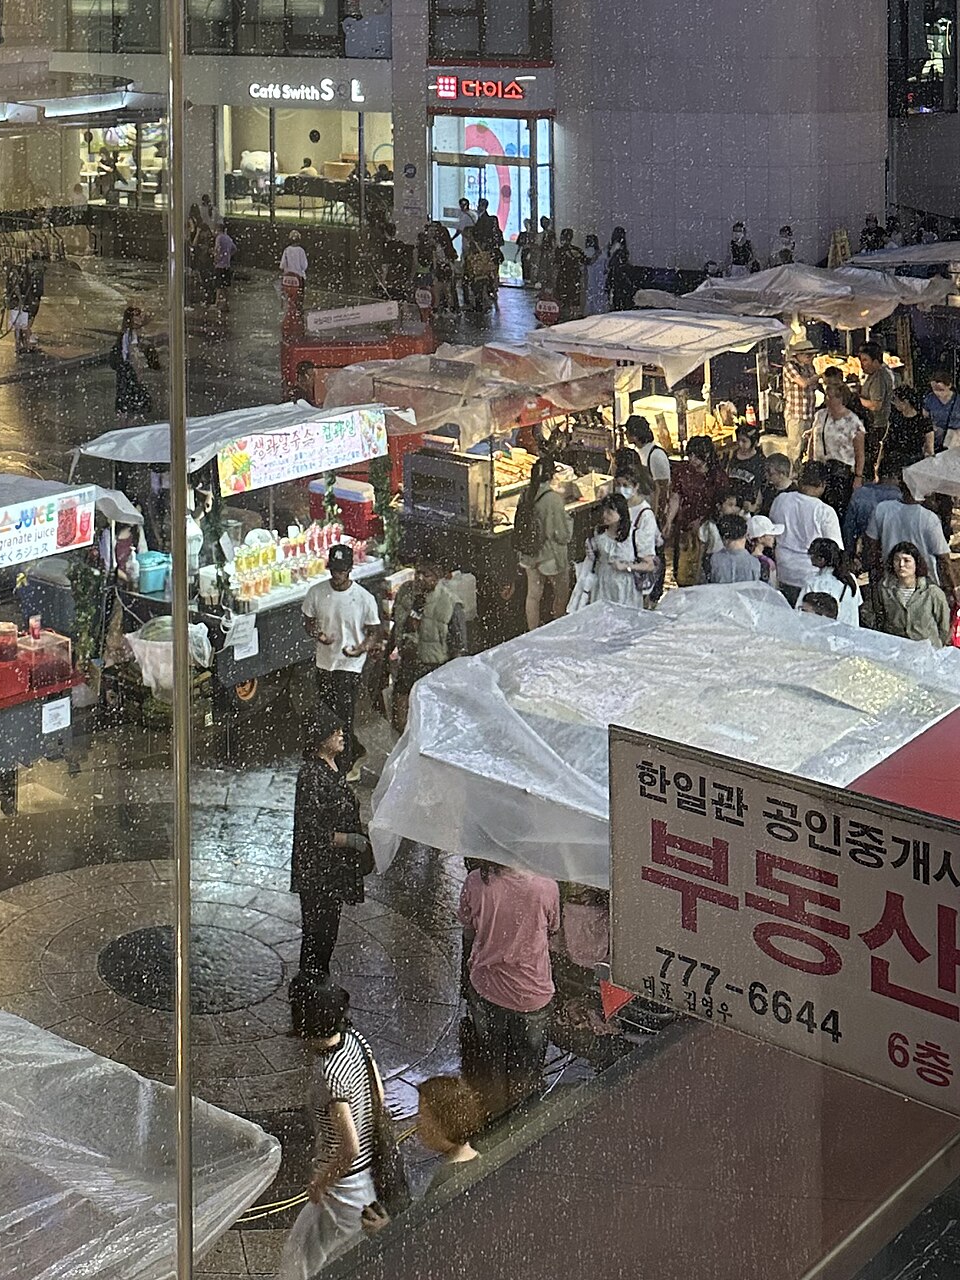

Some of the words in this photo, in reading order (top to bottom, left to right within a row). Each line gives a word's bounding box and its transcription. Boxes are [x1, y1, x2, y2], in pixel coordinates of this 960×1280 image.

[461, 80, 524, 100] 다이소
[15, 503, 56, 530] JUICE
[34, 526, 55, 543] juice
[636, 760, 749, 827] 한일관
[641, 817, 960, 1023] 부동산
[656, 946, 843, 1043] 777-6644
[886, 1032, 954, 1087] 6층
